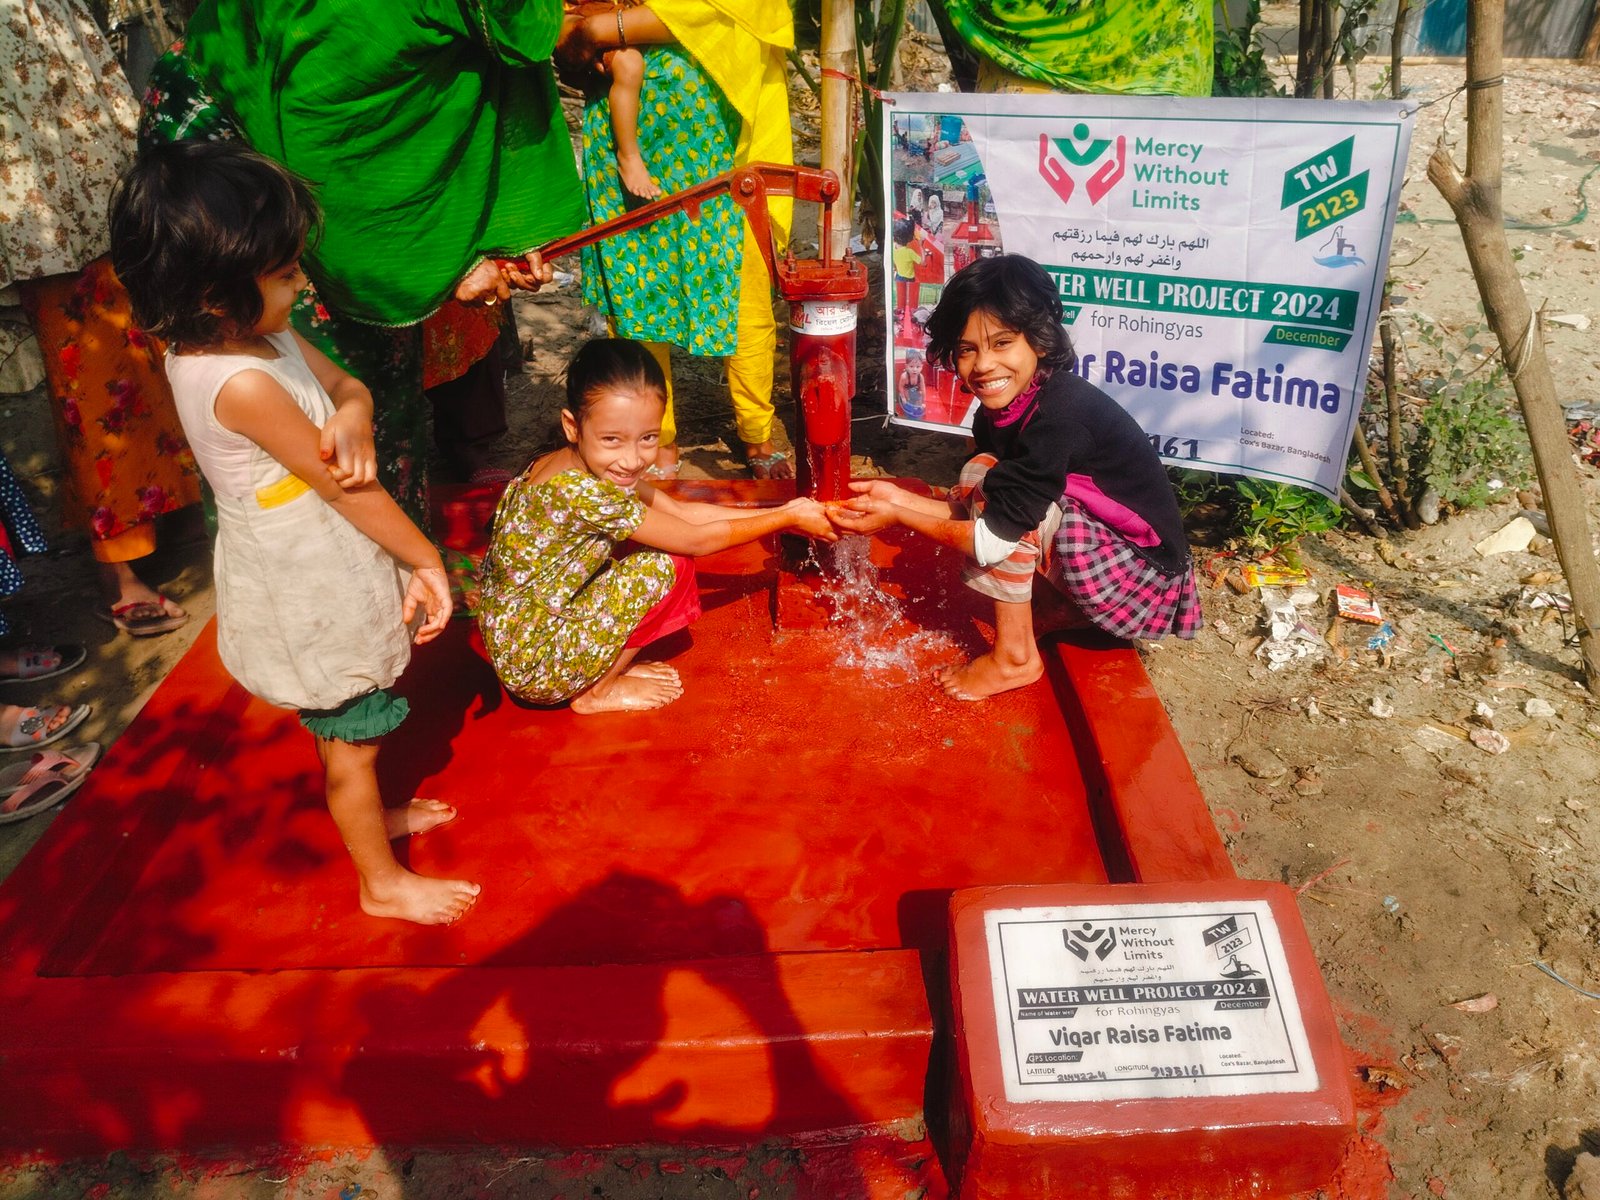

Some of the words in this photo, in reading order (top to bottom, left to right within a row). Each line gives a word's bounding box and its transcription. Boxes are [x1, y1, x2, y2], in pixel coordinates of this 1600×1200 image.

[1135, 136, 1204, 162] Mercy
[1133, 164, 1228, 187] Without
[1294, 155, 1338, 190] TW
[1132, 190, 1200, 211] Limits
[1302, 189, 1358, 228] 2123
[1096, 230, 1120, 245] فيما
[1122, 233, 1142, 247] لهم
[1146, 234, 1175, 250] بارك
[1178, 238, 1208, 250] اللهم
[1071, 250, 1121, 265] وارحمهم
[1124, 252, 1144, 266] لهم
[1148, 255, 1182, 270] واغفر
[1048, 272, 1086, 297] TER
[1094, 275, 1150, 304] WELL
[1158, 282, 1265, 314] PROJECT
[1271, 290, 1340, 321] 2024
[1063, 310, 1076, 319] ell
[1091, 311, 1114, 329] for
[1118, 314, 1204, 341] Rohingyas
[1276, 328, 1340, 347] December
[1105, 350, 1200, 393] Raisa
[1211, 362, 1341, 414] Fatima
[1240, 427, 1274, 440] Located:
[1240, 438, 1260, 448] Cox's
[1261, 440, 1286, 454] Bazar,
[1287, 446, 1331, 464] Bangladesh
[1119, 926, 1156, 937] Mercy
[1208, 924, 1232, 938] TW
[1120, 938, 1175, 948] Without
[1221, 938, 1244, 954] 2123
[1124, 950, 1163, 960] Limits
[1023, 990, 1080, 1004] WATER
[1084, 988, 1129, 1002] WELL
[1134, 984, 1206, 1000] PROJECT
[1213, 982, 1258, 996] 2024
[1096, 1008, 1114, 1016] for
[1118, 1006, 1181, 1016] Rohingyas
[1220, 1000, 1264, 1009] December
[1049, 1026, 1100, 1048] Viqar
[1108, 1024, 1160, 1044] Raisa
[1165, 1022, 1232, 1042] Fatima
[1028, 1054, 1043, 1062] GPS
[1045, 1054, 1078, 1062] Location:
[1254, 1058, 1286, 1066] Bangladesh
[1114, 1064, 1150, 1072] LONGITUDE
